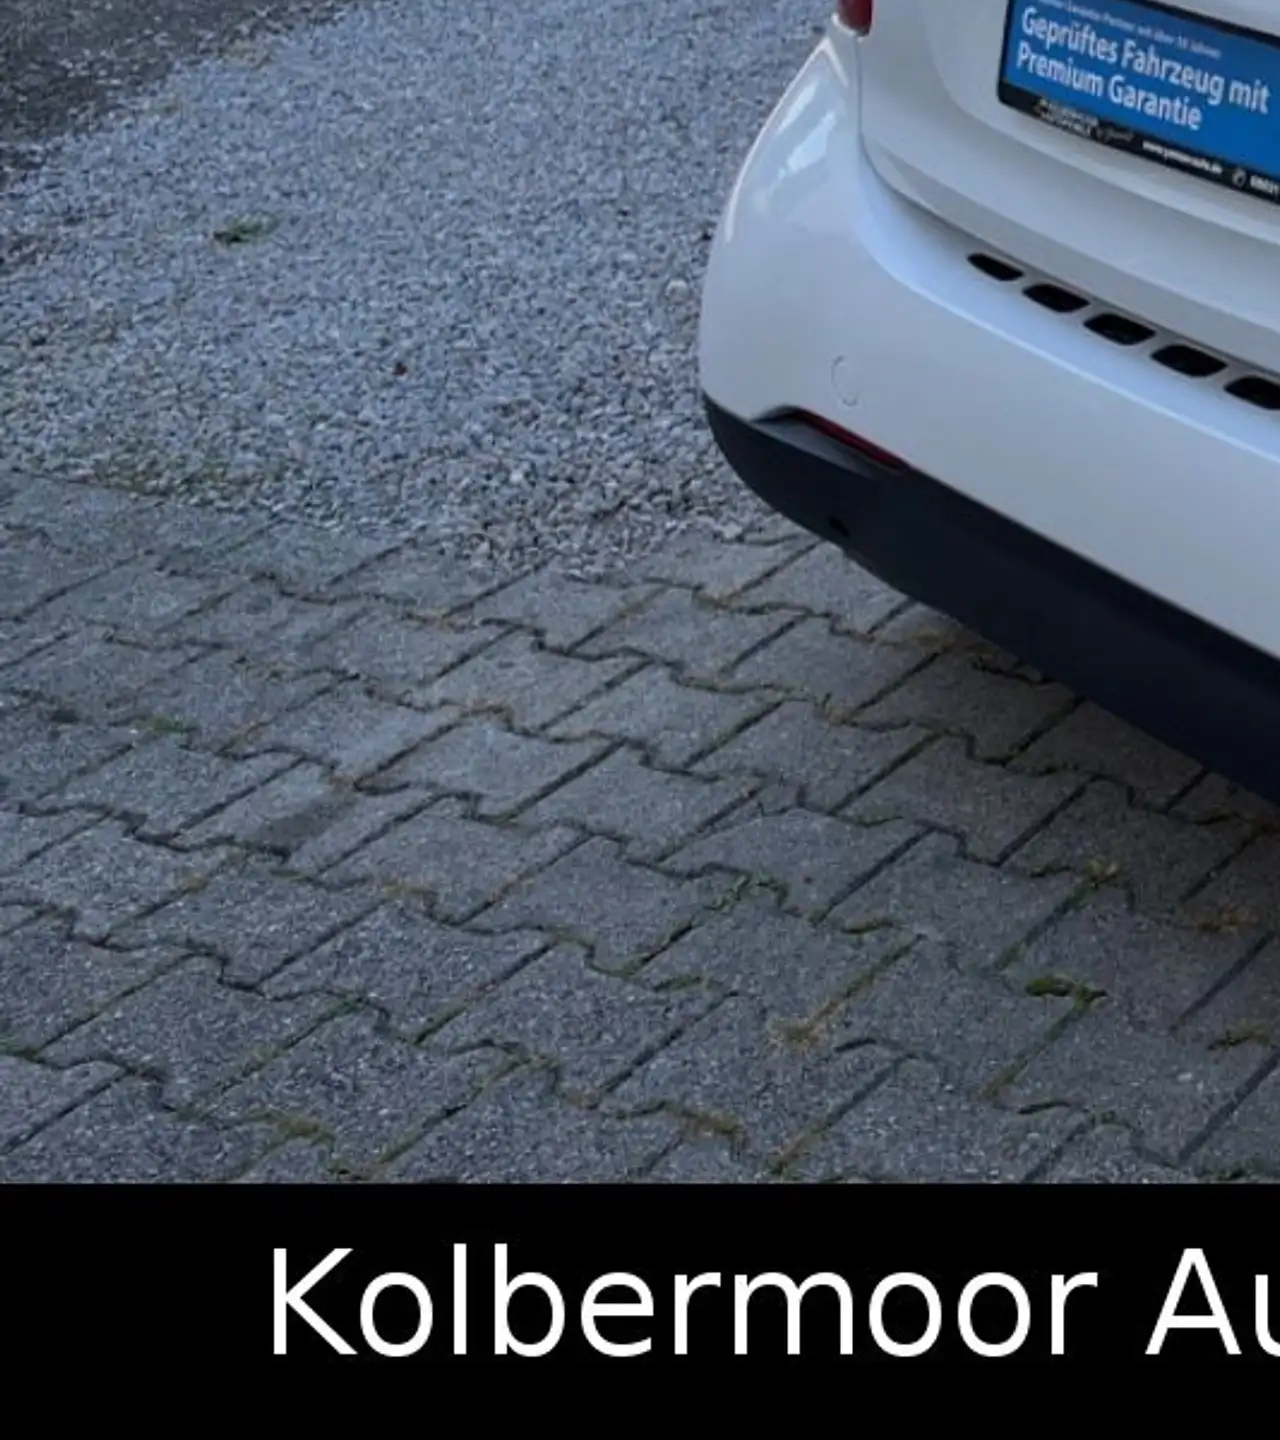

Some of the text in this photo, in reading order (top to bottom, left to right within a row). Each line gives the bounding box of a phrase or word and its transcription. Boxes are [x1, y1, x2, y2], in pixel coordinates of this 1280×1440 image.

[1016, 40, 1103, 97] Premium
[1107, 75, 1203, 130] Garantie
[1022, 6, 1117, 64] Geprüftes
[1121, 39, 1225, 106] Fahrzeug
[1228, 79, 1271, 114] mit
